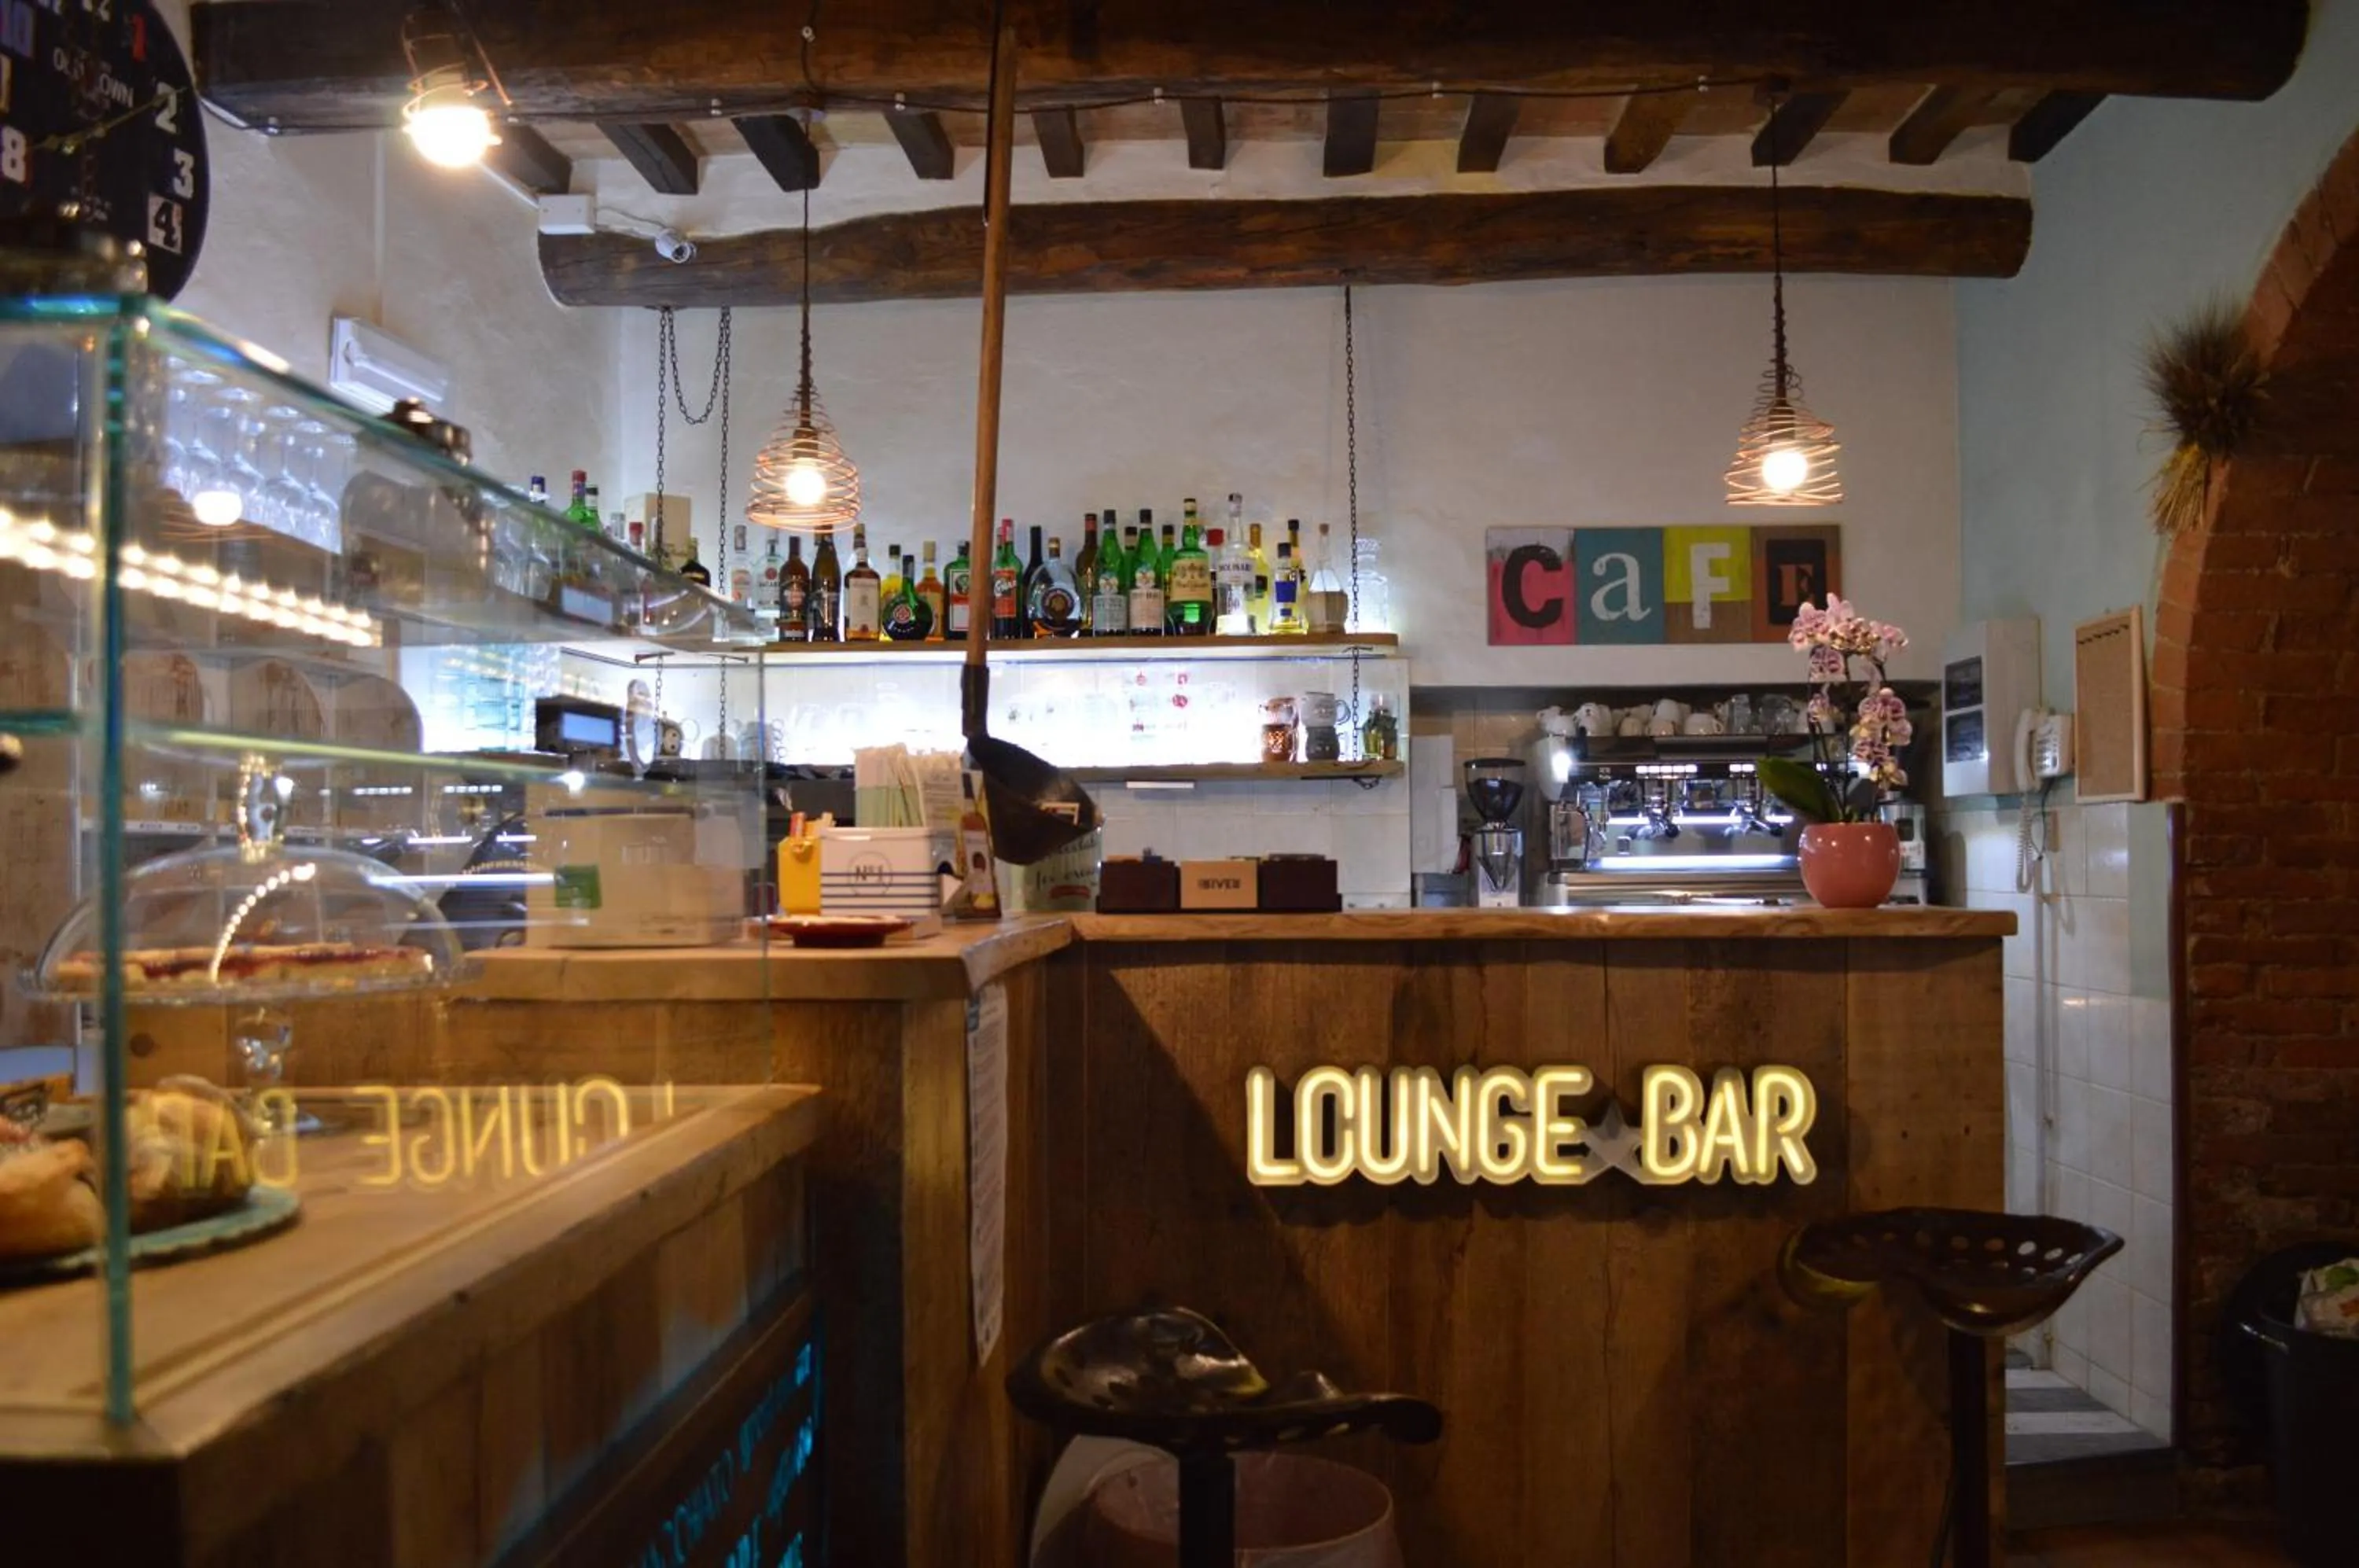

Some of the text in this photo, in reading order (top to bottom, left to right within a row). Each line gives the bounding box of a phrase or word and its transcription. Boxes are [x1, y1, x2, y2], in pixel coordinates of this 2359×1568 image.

[155, 81, 177, 134] 2
[1, 125, 27, 183] 8
[172, 148, 195, 198] 3
[154, 200, 178, 248] 4
[1248, 1066, 1815, 1184] LOUNGE BAR
